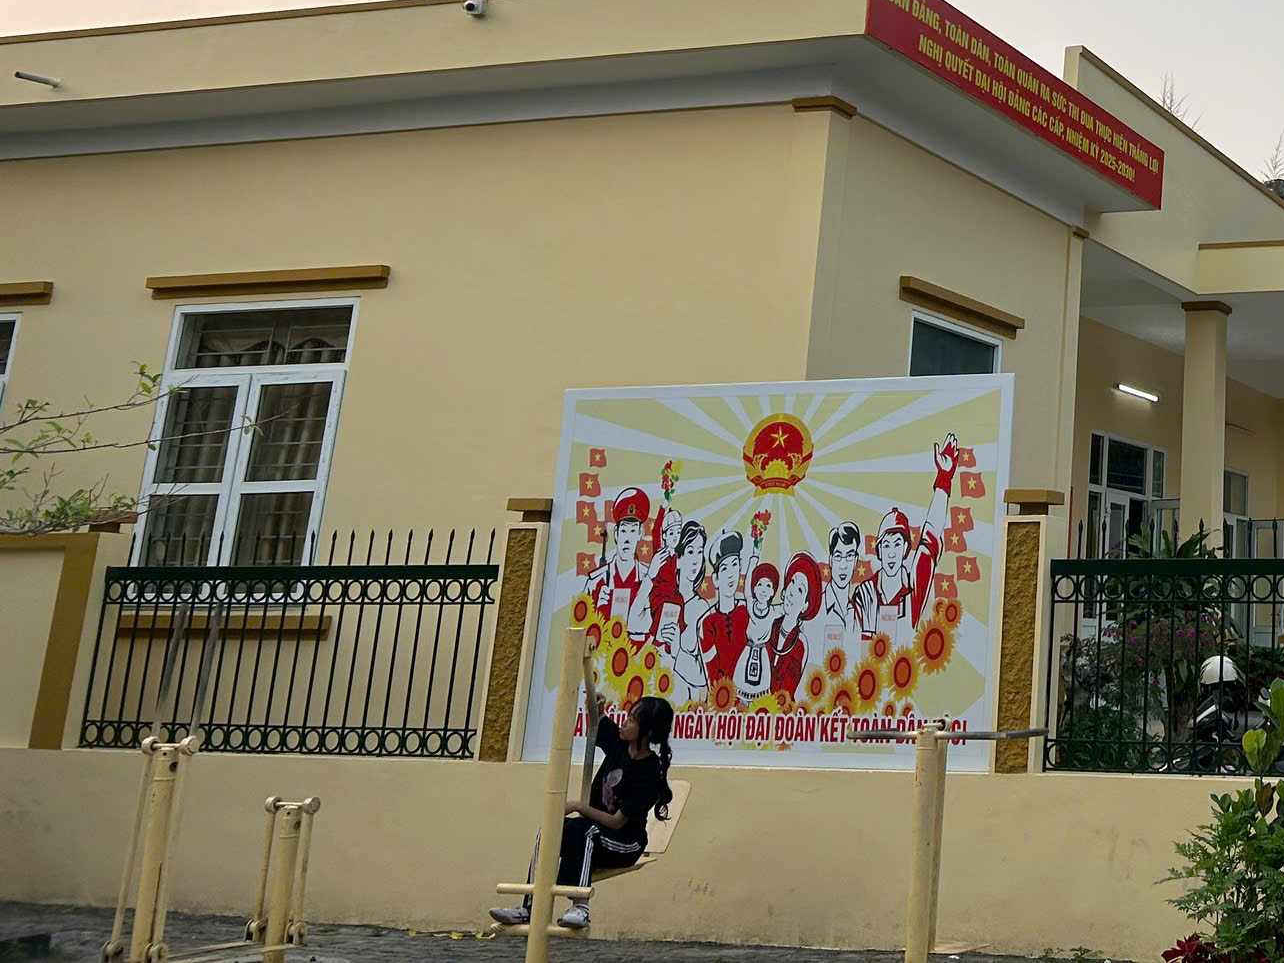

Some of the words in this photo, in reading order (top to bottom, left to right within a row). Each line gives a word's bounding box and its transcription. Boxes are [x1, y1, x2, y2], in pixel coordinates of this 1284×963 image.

[918, 34, 944, 67] NGHỊ
[945, 51, 975, 82] QUYẾT
[975, 69, 991, 94] ĐẠI
[992, 80, 1007, 104] HỘI
[1008, 89, 1031, 117] ĐẢNG
[1031, 105, 1048, 128] CÁC
[1066, 127, 1089, 153] NHIỆM
[1089, 142, 1100, 160] KỲ
[945, 19, 970, 50] TOÀN
[970, 38, 992, 66] DÂN,
[994, 52, 1017, 80] TOÀN
[1017, 68, 1040, 95] QUÂN
[1040, 83, 1050, 103] RA
[1052, 91, 1067, 113] SỨC
[1068, 101, 1080, 121] THI
[1080, 110, 1094, 131] ĐUA
[1095, 120, 1112, 143] THỰC
[673, 708, 713, 740] NGÀY
[715, 709, 742, 745] HỘI
[745, 715, 770, 746] ĐẠI
[774, 711, 817, 742] ĐOÀN
[819, 709, 849, 743] KẾT
